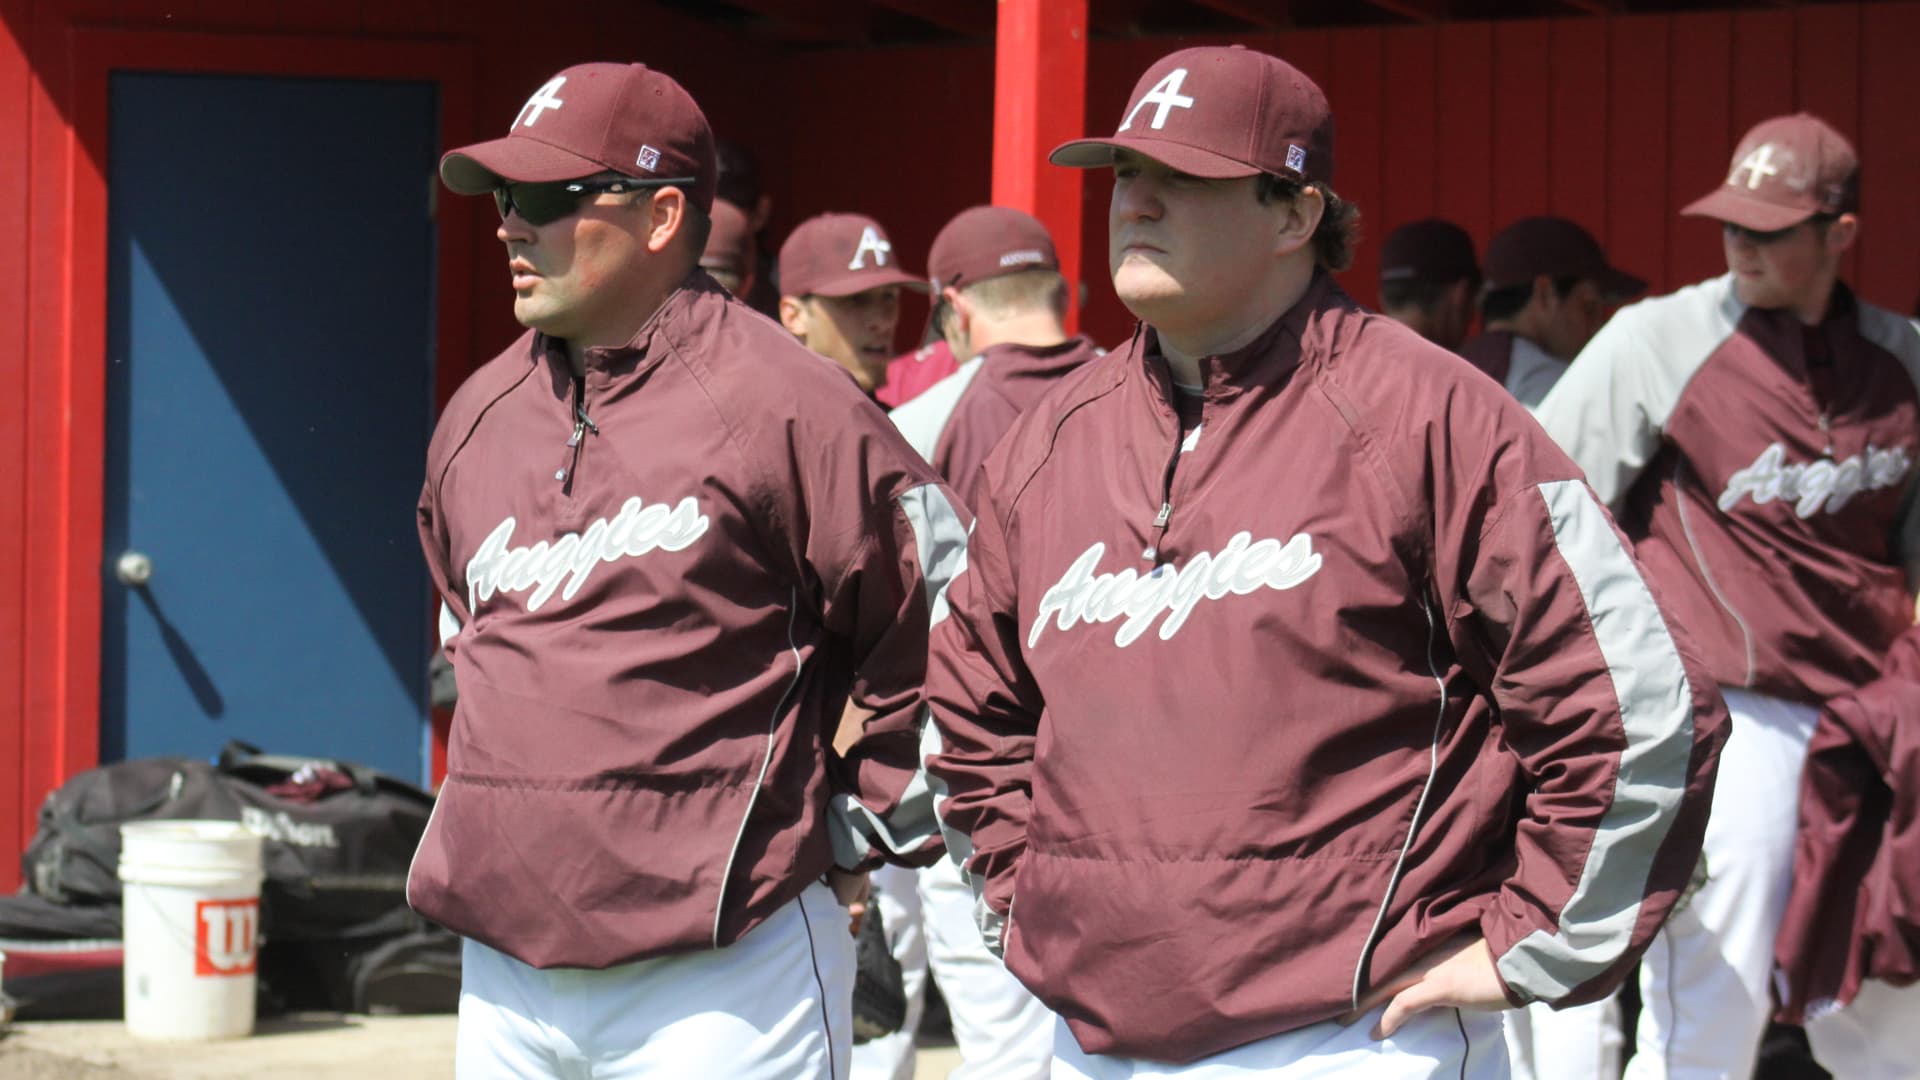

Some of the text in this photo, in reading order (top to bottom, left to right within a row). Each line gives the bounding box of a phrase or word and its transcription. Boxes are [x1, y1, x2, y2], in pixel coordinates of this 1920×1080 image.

[510, 76, 567, 132] A
[1118, 68, 1194, 132] A
[1727, 143, 1777, 190] A
[848, 226, 891, 270] A
[1028, 531, 1322, 648] Auggies
